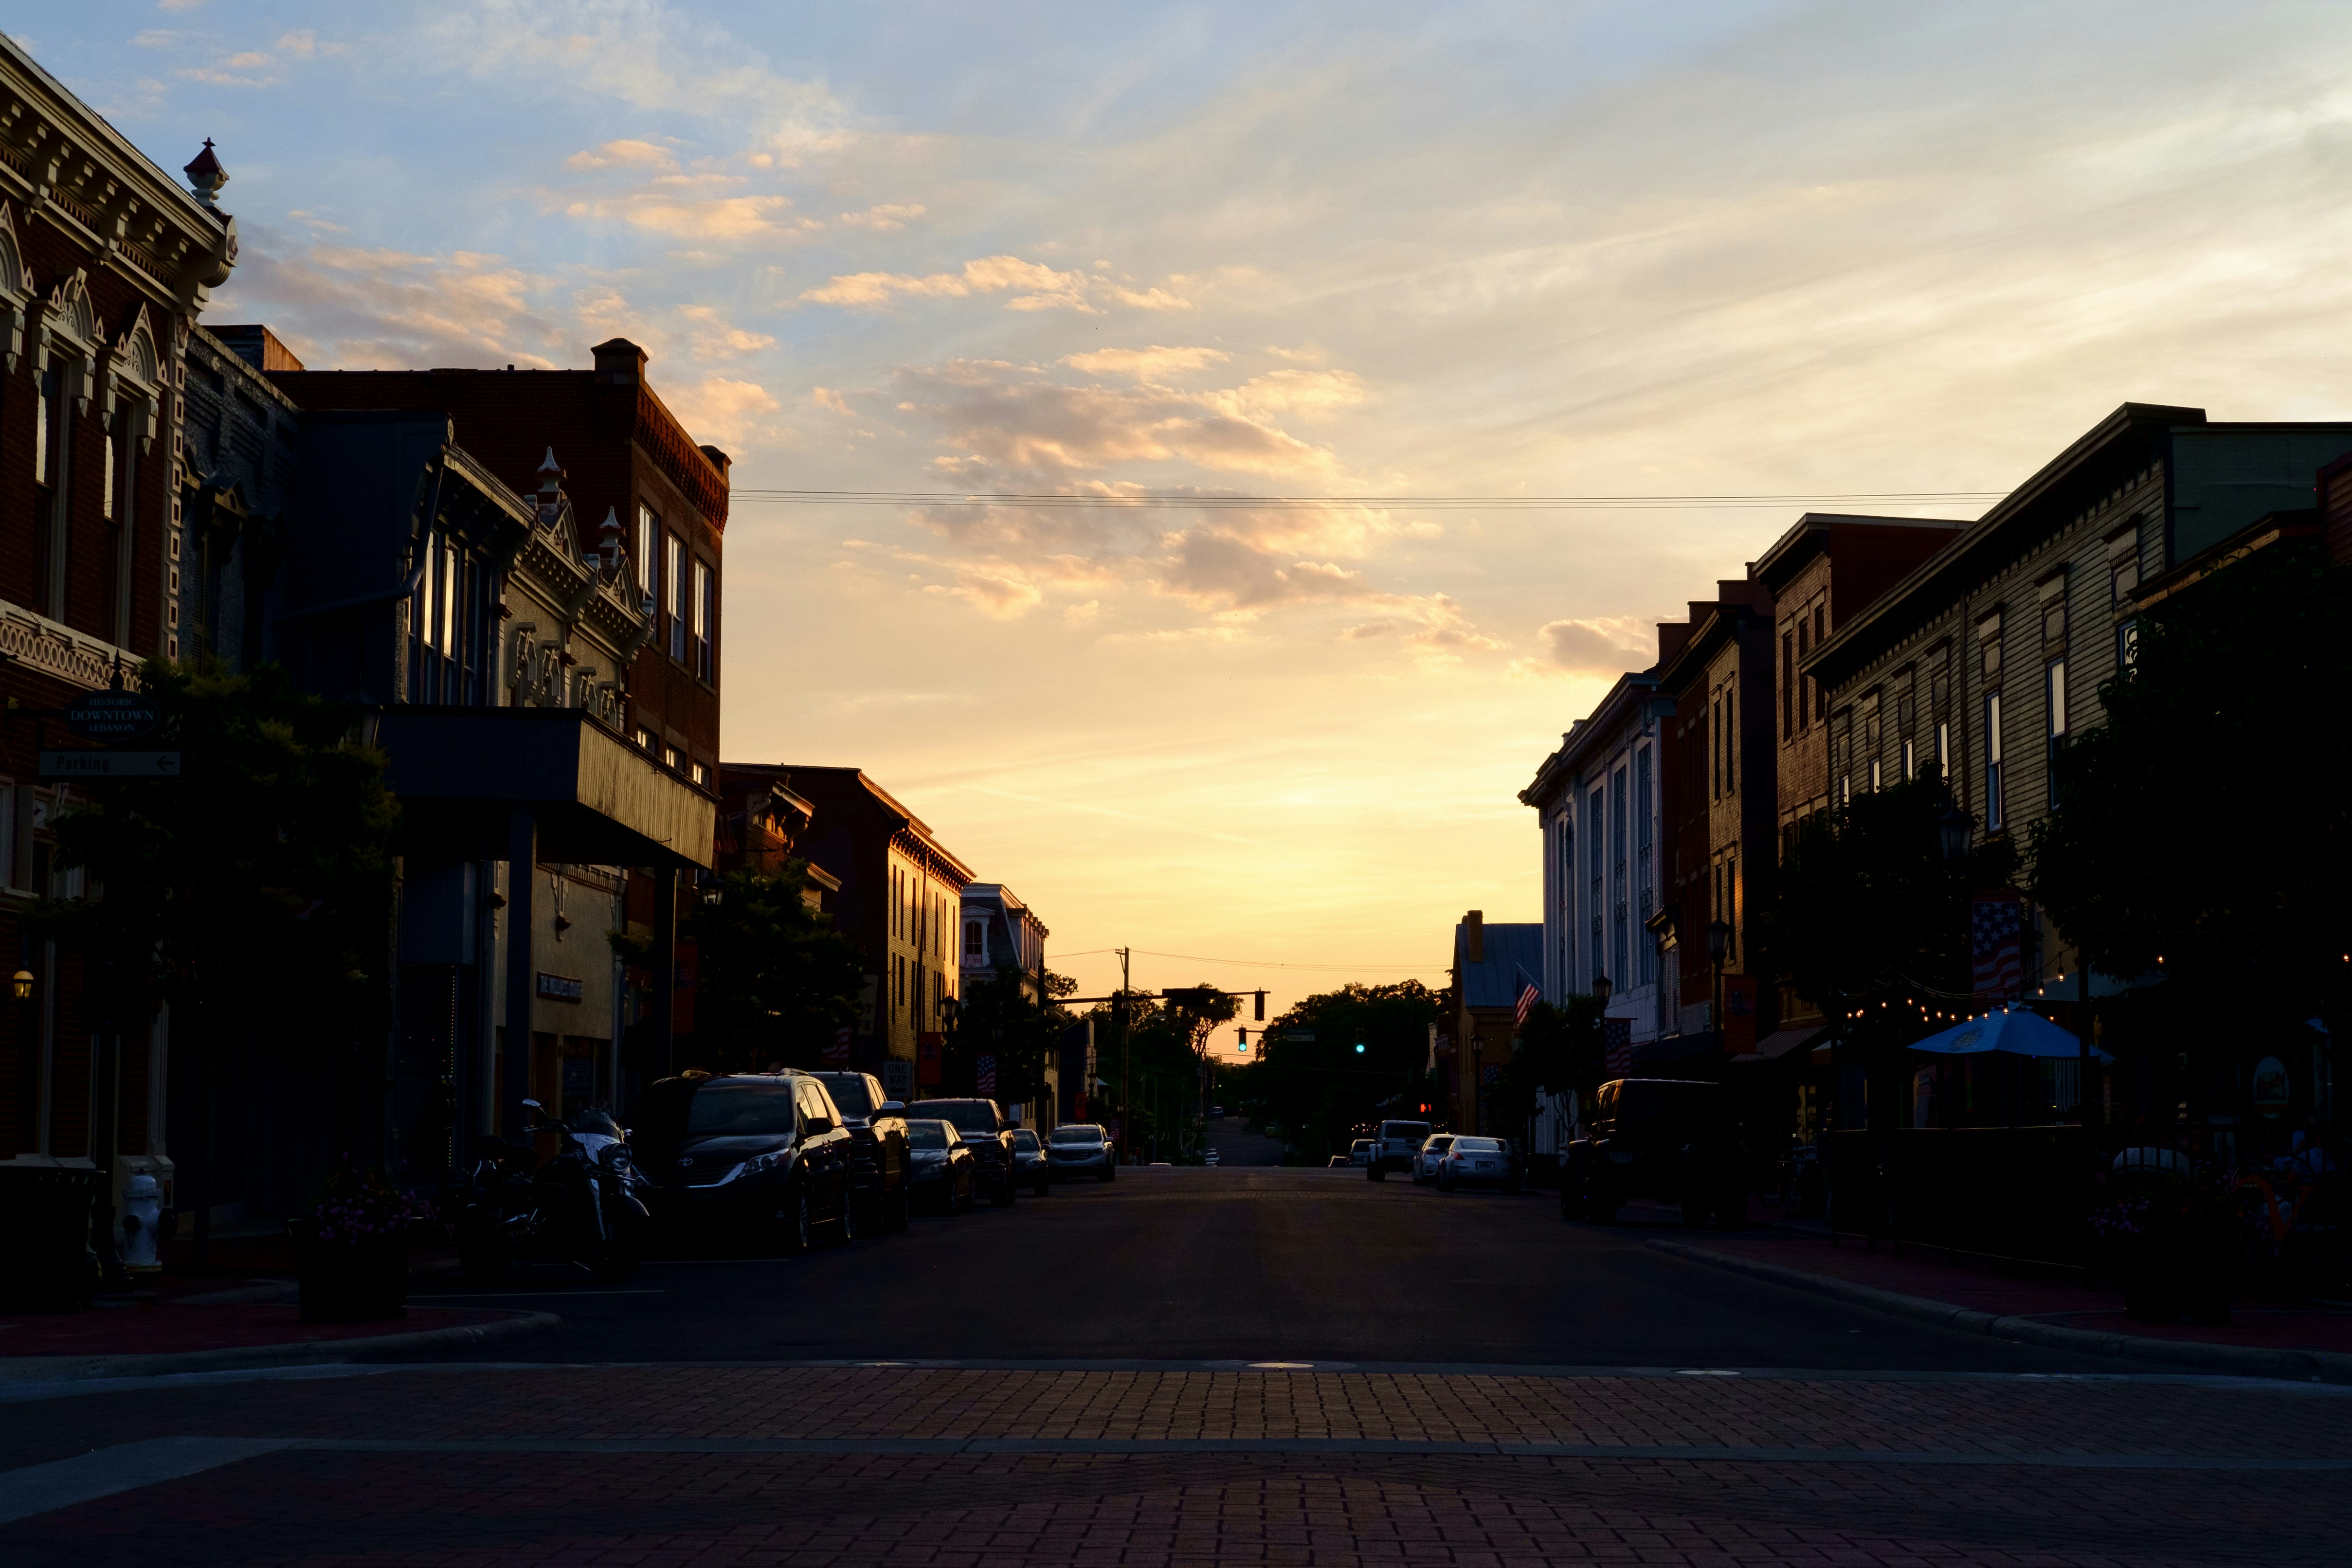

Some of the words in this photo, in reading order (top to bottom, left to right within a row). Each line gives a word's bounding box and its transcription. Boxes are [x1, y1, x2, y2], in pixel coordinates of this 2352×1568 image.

[71, 710, 154, 720] DOWNTOWN
[57, 756, 109, 772] Parking
[888, 1064, 906, 1074] ONE
[889, 1075, 906, 1085] WAY
